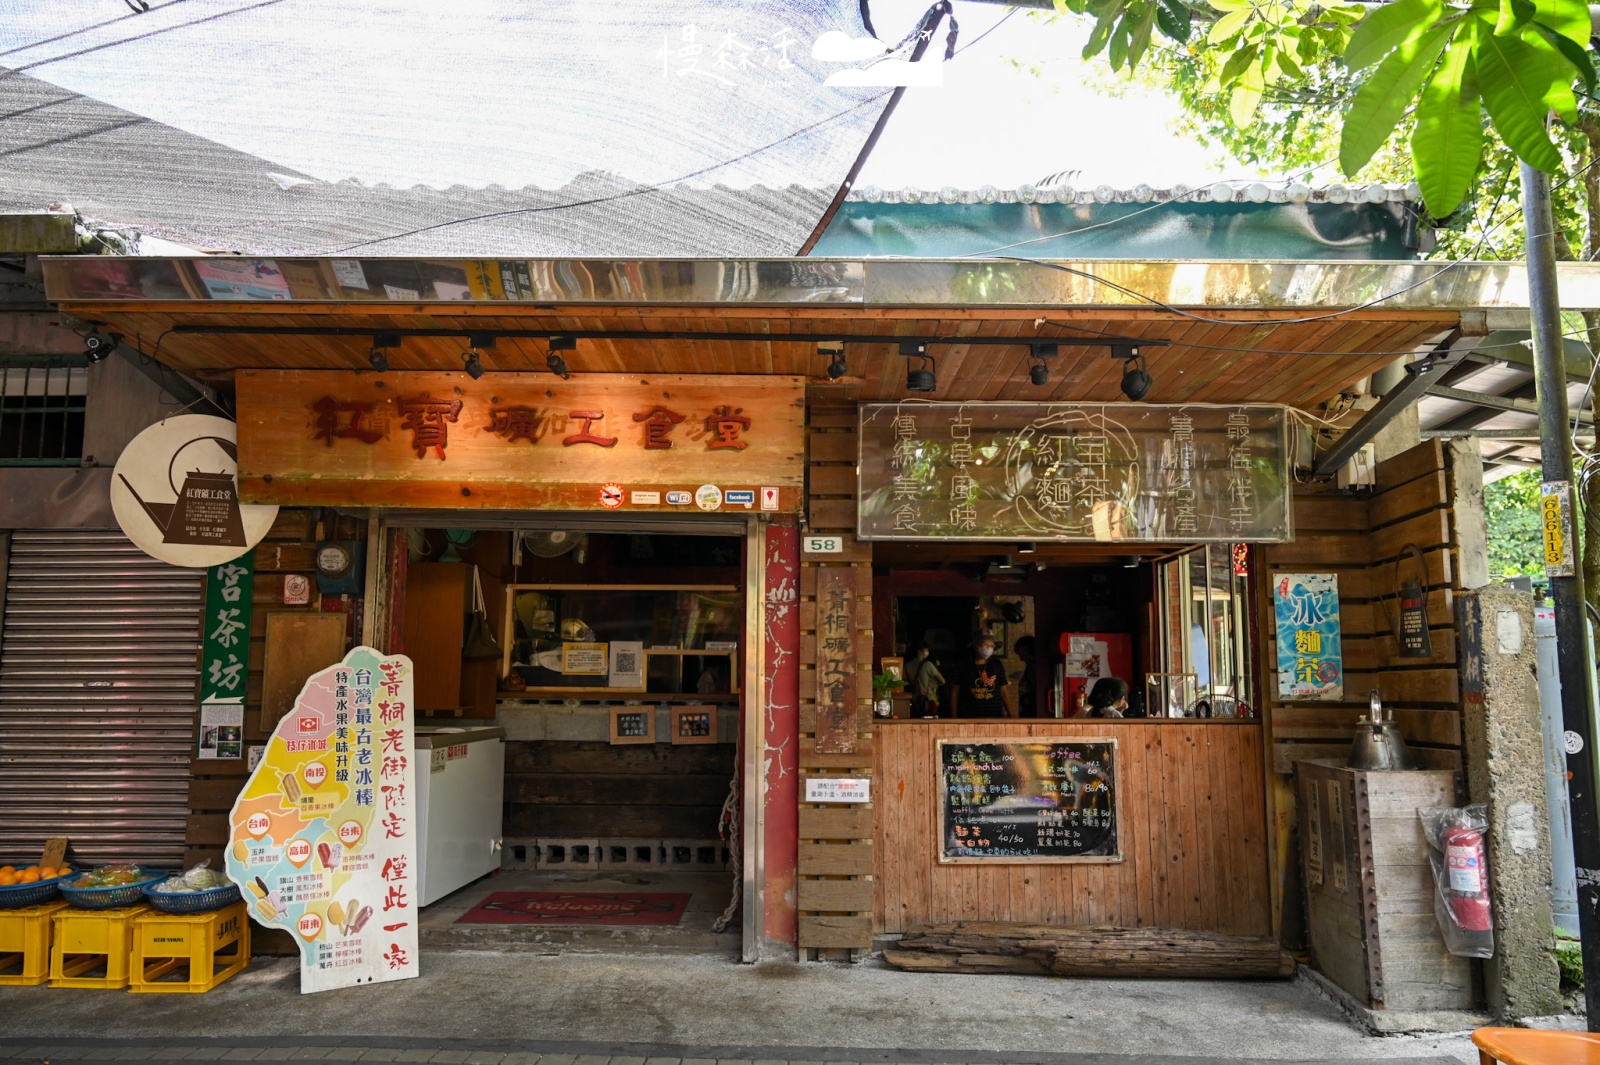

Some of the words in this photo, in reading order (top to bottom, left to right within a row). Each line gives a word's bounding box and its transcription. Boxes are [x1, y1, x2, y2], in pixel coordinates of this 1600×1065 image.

[891, 414, 919, 532] 傳統美食
[949, 418, 977, 531] 古早風味
[1544, 500, 1559, 563] 606113
[810, 539, 835, 551] 58
[335, 672, 348, 782] 特產水果美味升級
[355, 669, 373, 806] 台灣最古老冰棒
[1043, 746, 1081, 759] Coffee
[305, 768, 325, 778] 南投
[301, 803, 334, 812] 百香果冰棒
[248, 818, 269, 828] 台南
[340, 827, 361, 836] 台東
[998, 834, 1024, 843] 40/50
[289, 845, 310, 856] 高雄
[251, 854, 279, 864] 芒果雪糕
[296, 874, 324, 882] 香蕉雪糕
[526, 900, 635, 912] Welcome
[299, 920, 320, 930] 屏東
[335, 939, 362, 948] 芒果雪糕
[319, 952, 332, 960] 屏東
[335, 948, 362, 958] 檸檬冰棒
[320, 962, 332, 970] 萬丹
[335, 958, 362, 967] 紅豆冰棒
